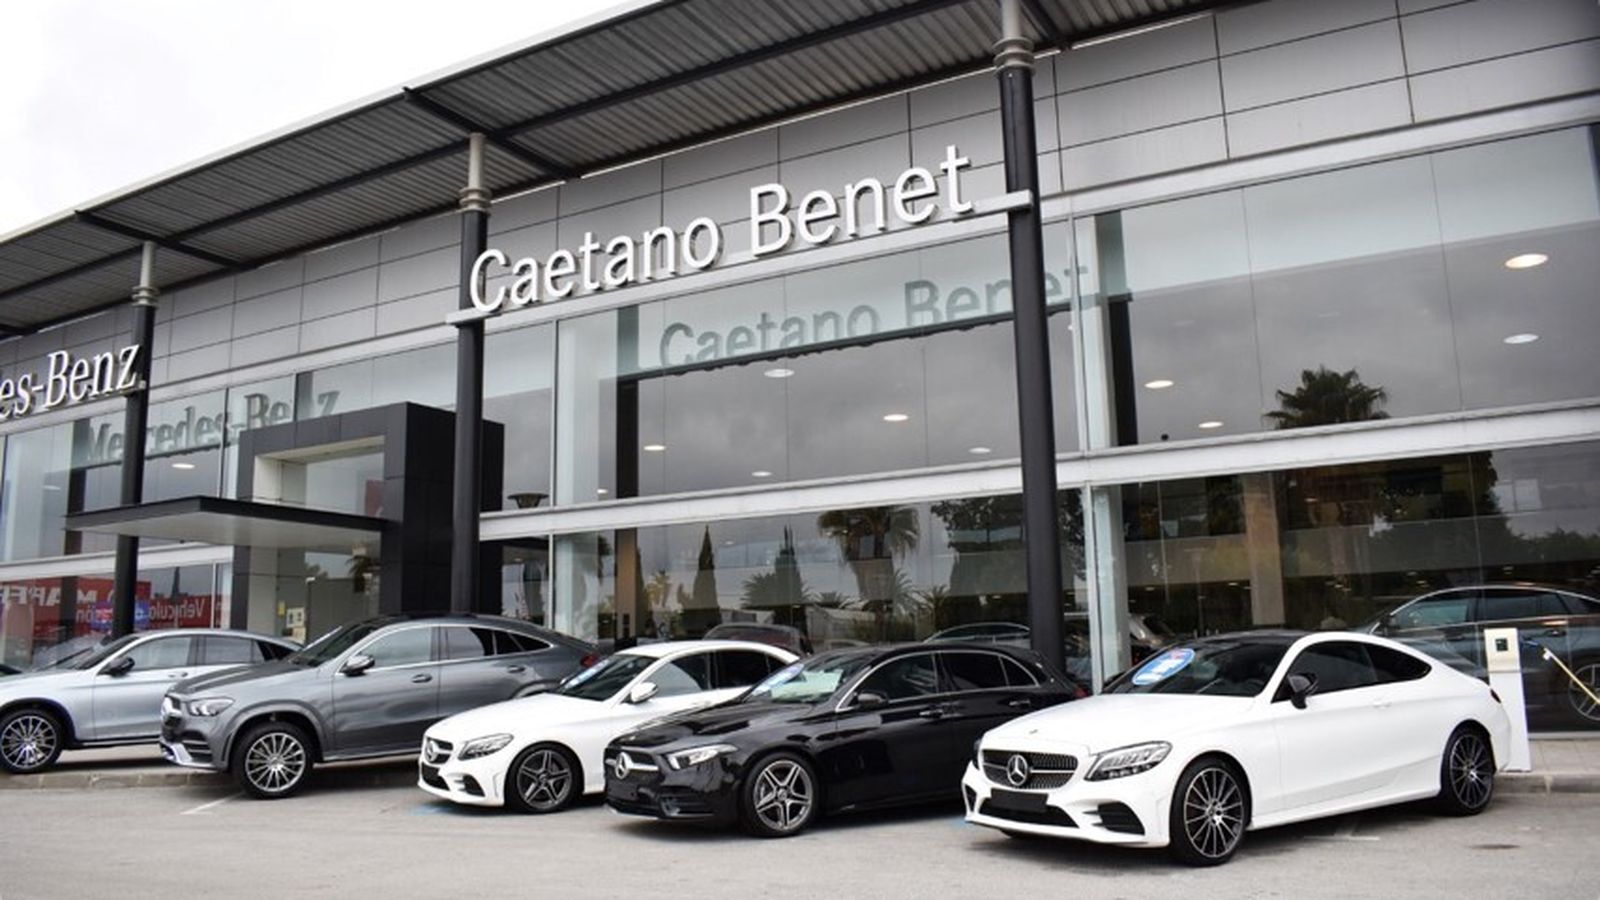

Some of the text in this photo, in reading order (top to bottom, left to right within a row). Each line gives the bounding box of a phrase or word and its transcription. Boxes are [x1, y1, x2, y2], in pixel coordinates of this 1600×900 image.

[469, 145, 972, 313] Caetano Benet
[659, 304, 880, 368] Caetano
[0, 344, 140, 419] es-Benz
